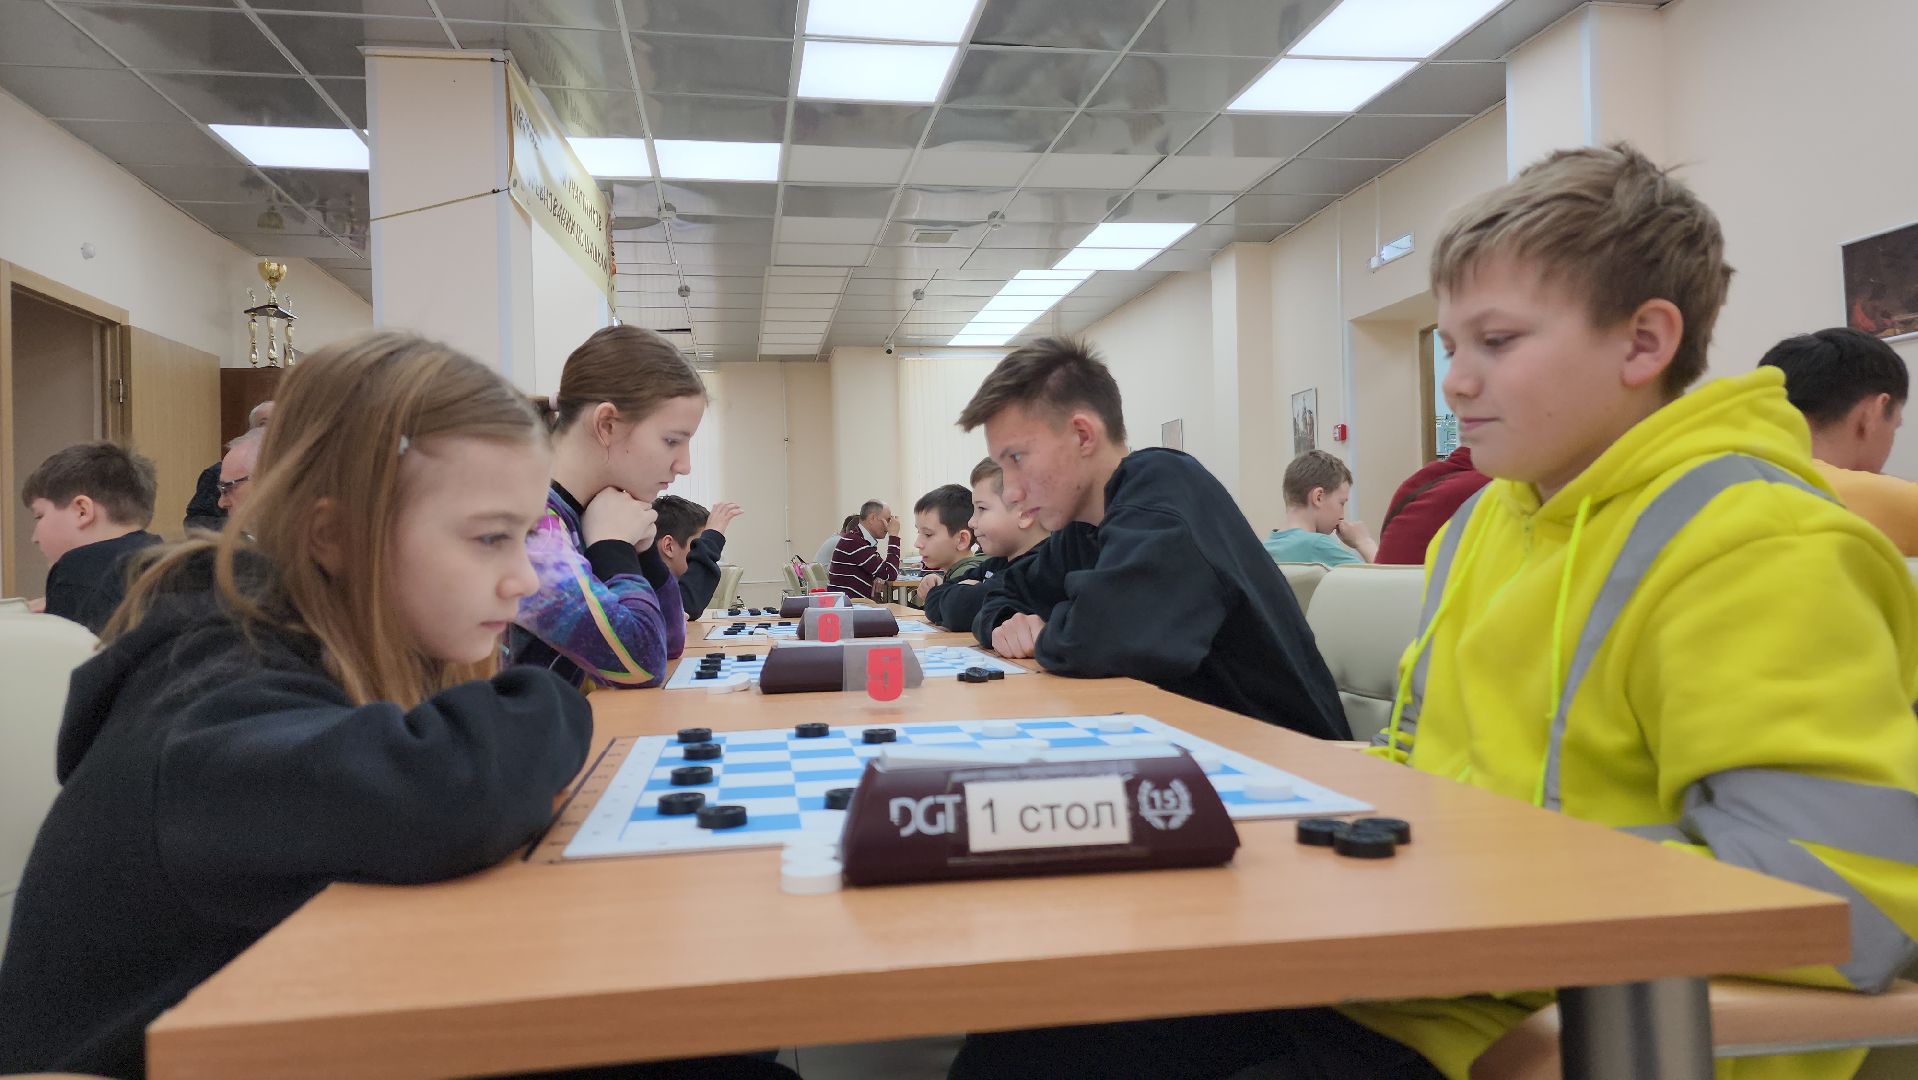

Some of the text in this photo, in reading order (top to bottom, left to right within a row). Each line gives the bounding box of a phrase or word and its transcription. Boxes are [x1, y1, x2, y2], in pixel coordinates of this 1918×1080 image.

[889, 794, 961, 837] DGT
[981, 798, 1117, 833] 1 стол
[1149, 788, 1178, 810] 15
